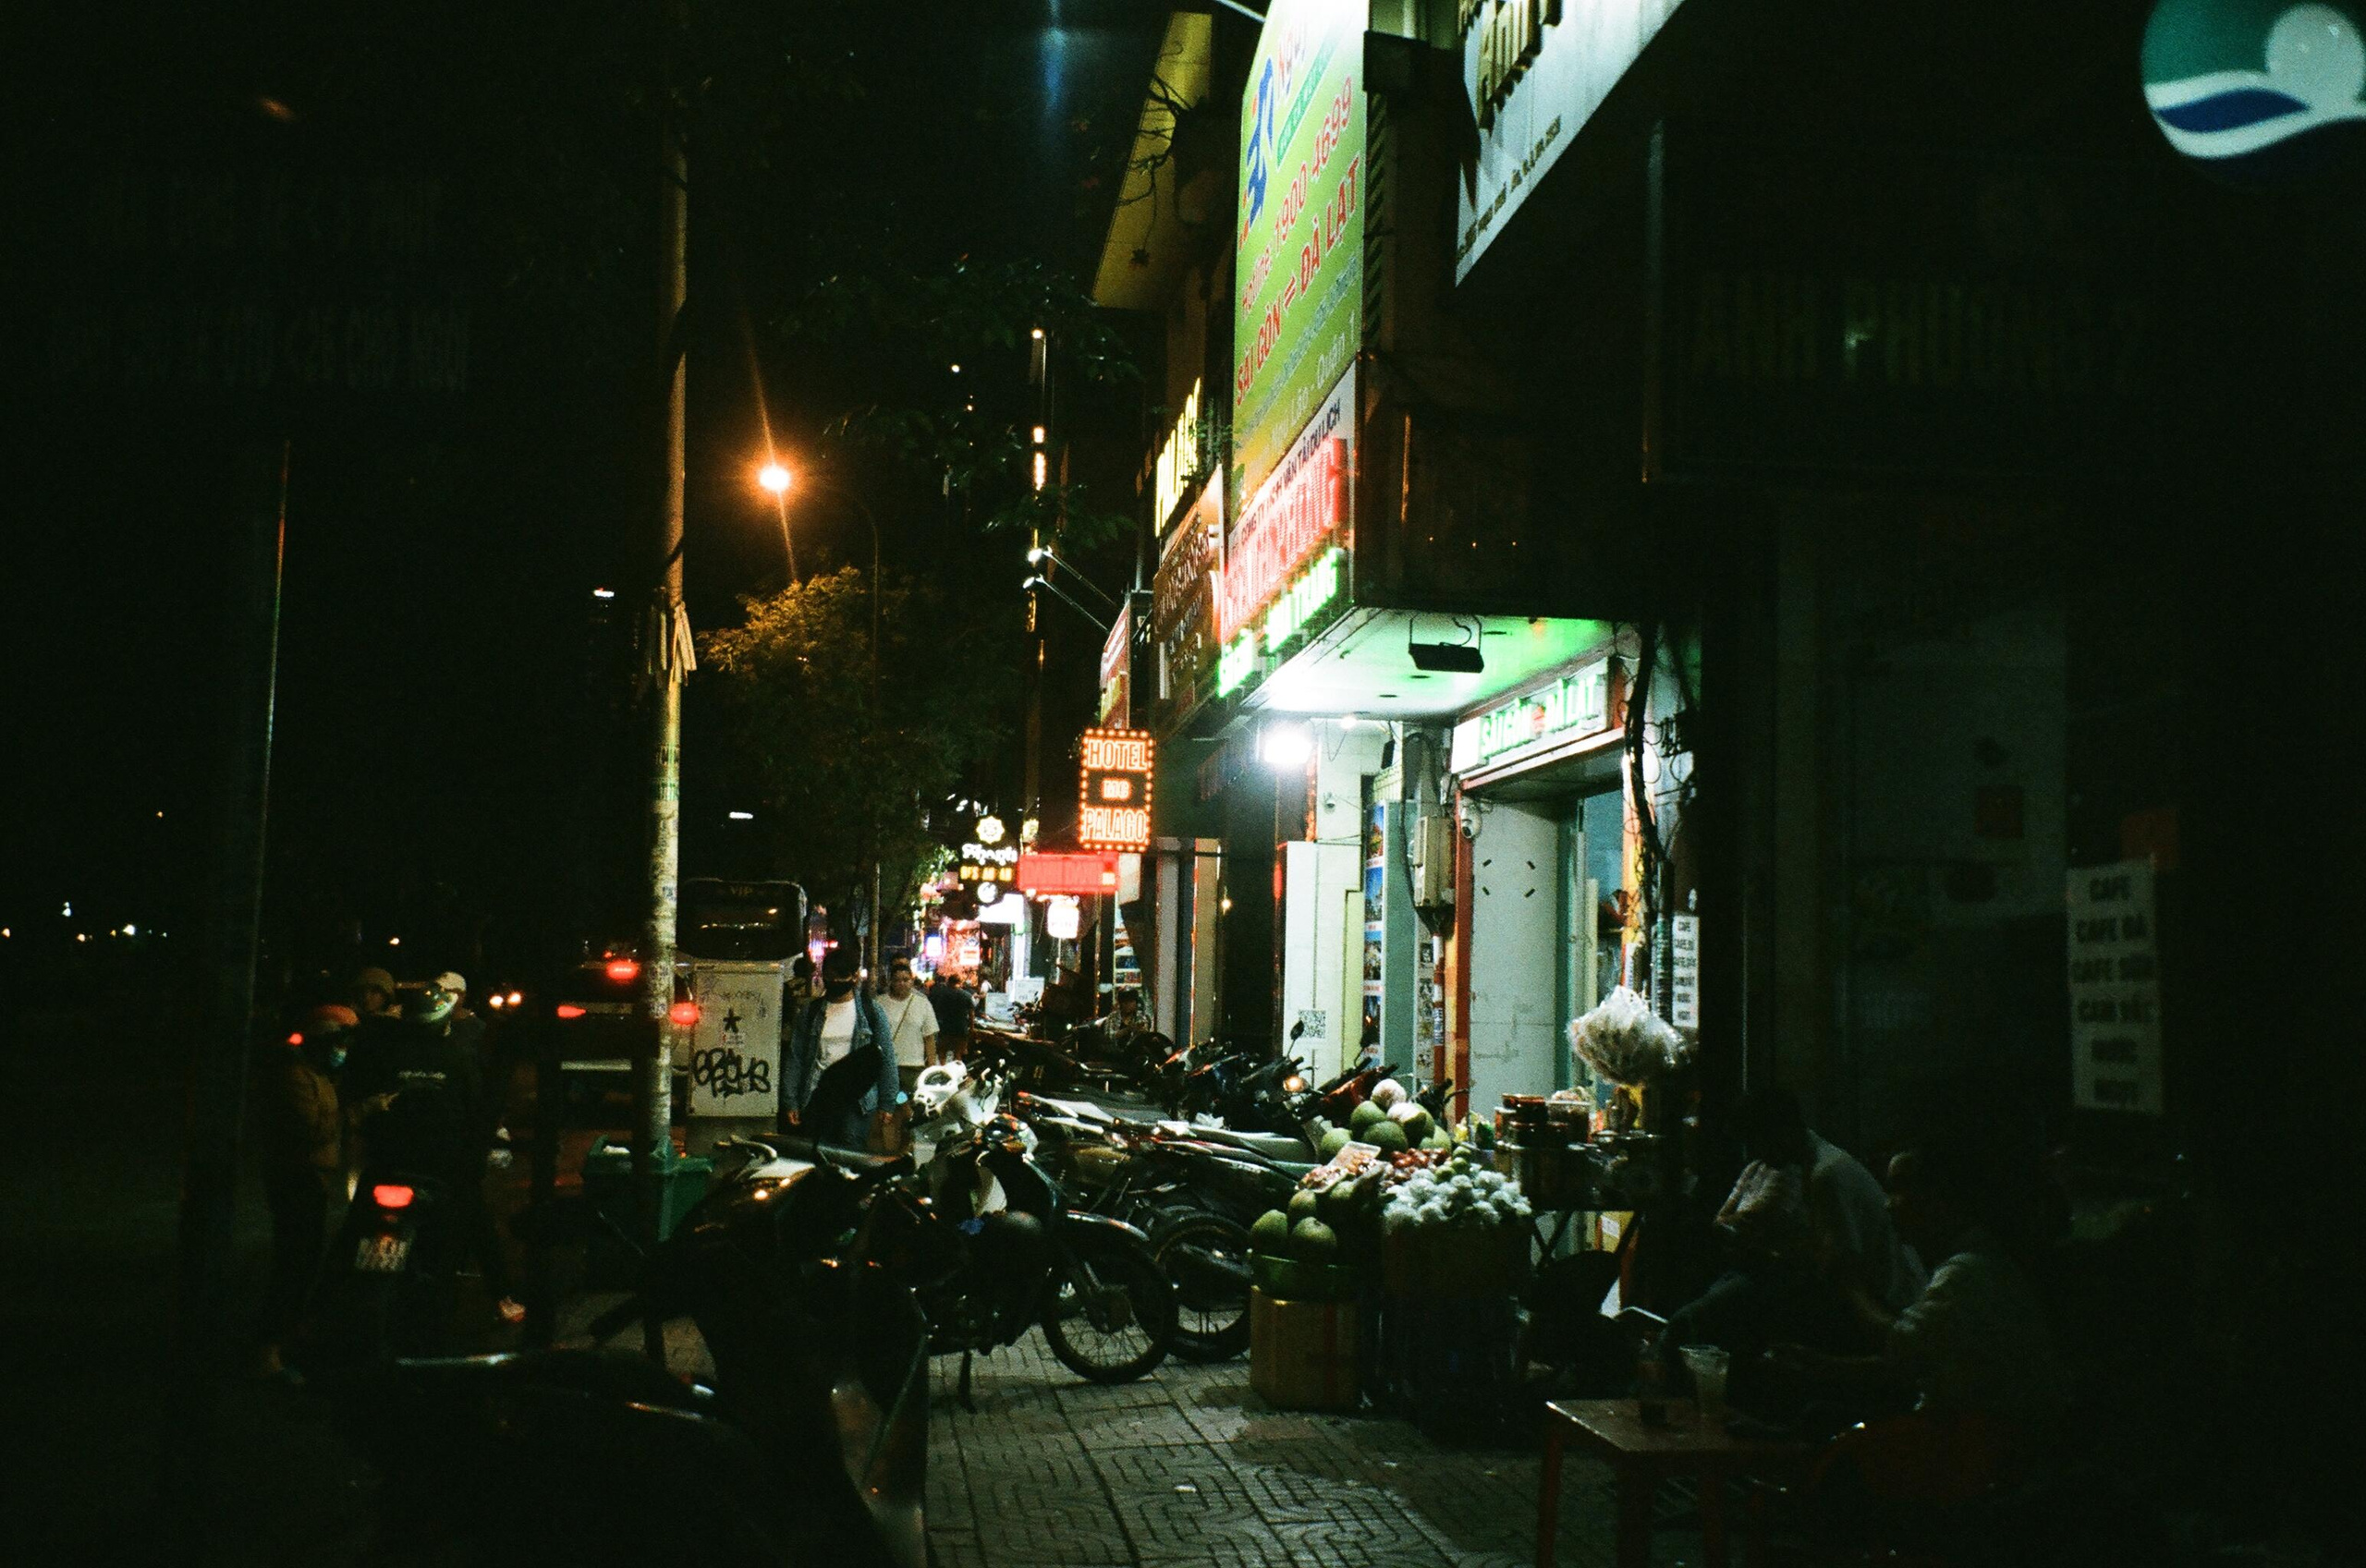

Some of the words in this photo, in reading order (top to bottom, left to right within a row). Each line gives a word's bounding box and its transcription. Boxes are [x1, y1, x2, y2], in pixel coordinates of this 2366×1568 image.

[1274, 161, 1308, 255] 1900
[1311, 76, 1352, 176] 4699
[1257, 294, 1281, 370] GÒN
[1300, 214, 1321, 296] ĐÀ
[1325, 154, 1360, 252] LẠT
[1348, 309, 1356, 345] 1
[1087, 738, 1148, 771] HOTEL
[1083, 808, 1147, 843] PALAGO
